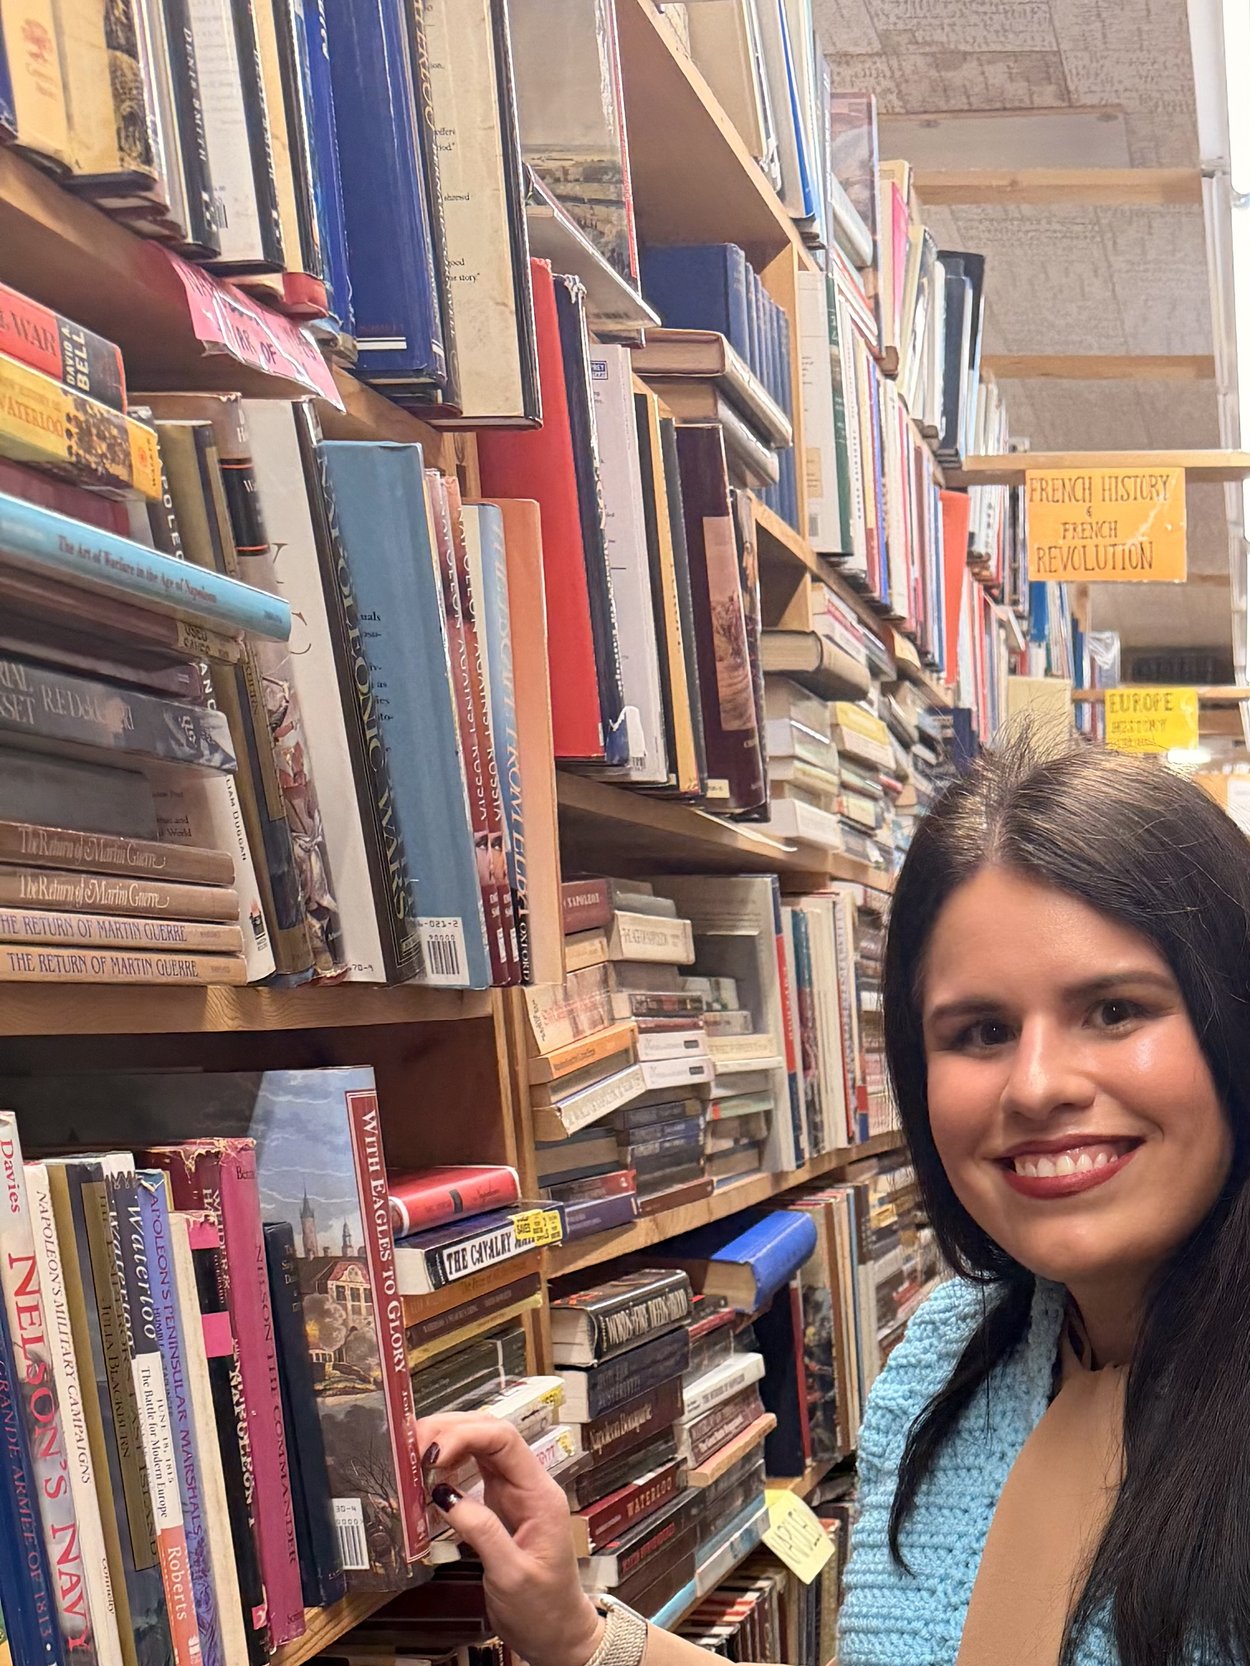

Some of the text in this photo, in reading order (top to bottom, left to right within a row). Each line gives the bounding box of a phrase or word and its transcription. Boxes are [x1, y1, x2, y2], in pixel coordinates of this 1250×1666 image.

[12, 311, 57, 357] WAR
[63, 341, 76, 386] DAVID
[73, 331, 91, 392] BELL
[1029, 474, 1170, 503] FRENCH HISTORY
[1036, 542, 1153, 573] REVOLUTION
[1061, 521, 1118, 540] FRENCH
[1109, 692, 1173, 713] EUROPE
[470, 745, 486, 820] RUSSIA
[487, 747, 501, 820] RUSSIA
[232, 810, 247, 862] DUGGAN
[39, 876, 127, 905] Return Martin
[23, 917, 187, 943] RETURN OF MARTIN GUERRE
[7, 953, 199, 979] THE RETURN OF MARTIN GUERRE
[0, 1139, 21, 1214] Davies
[127, 1202, 156, 1340] Waterloo
[361, 1108, 406, 1374] WITH EAGLES TO GLORY
[446, 1232, 513, 1275] THE CAVALRY
[36, 1190, 91, 1485] NAPOLEON'S MILITARY CAMPAIGNS
[163, 1301, 202, 1533] PENINSULAR MARSHALS
[254, 1246, 297, 1565] NELSON COMMANDER
[8, 1253, 91, 1652] NELSON'S NAVY
[151, 1437, 168, 1519] Modern Europe
[626, 1476, 673, 1518] WATERLOO
[28, 1551, 51, 1639] OF 1813
[167, 1546, 188, 1621] Roberts
